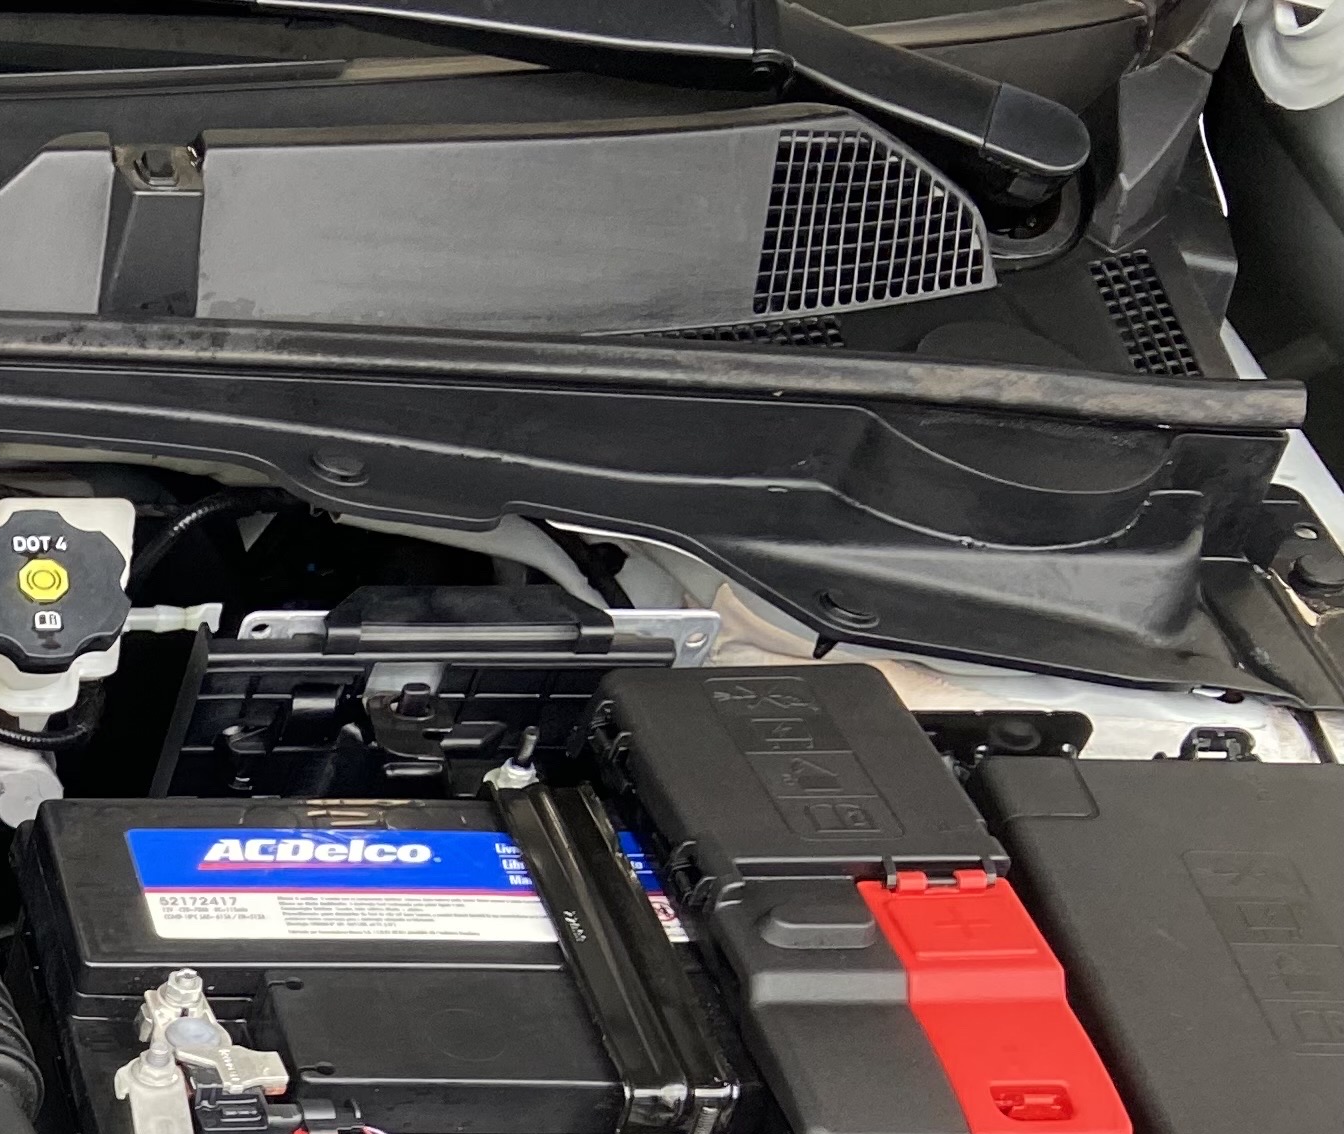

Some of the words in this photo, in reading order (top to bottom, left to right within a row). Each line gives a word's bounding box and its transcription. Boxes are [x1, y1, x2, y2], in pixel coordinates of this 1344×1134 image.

[12, 535, 52, 552] DOT
[55, 536, 67, 551] 4
[203, 838, 433, 863] ACDelco
